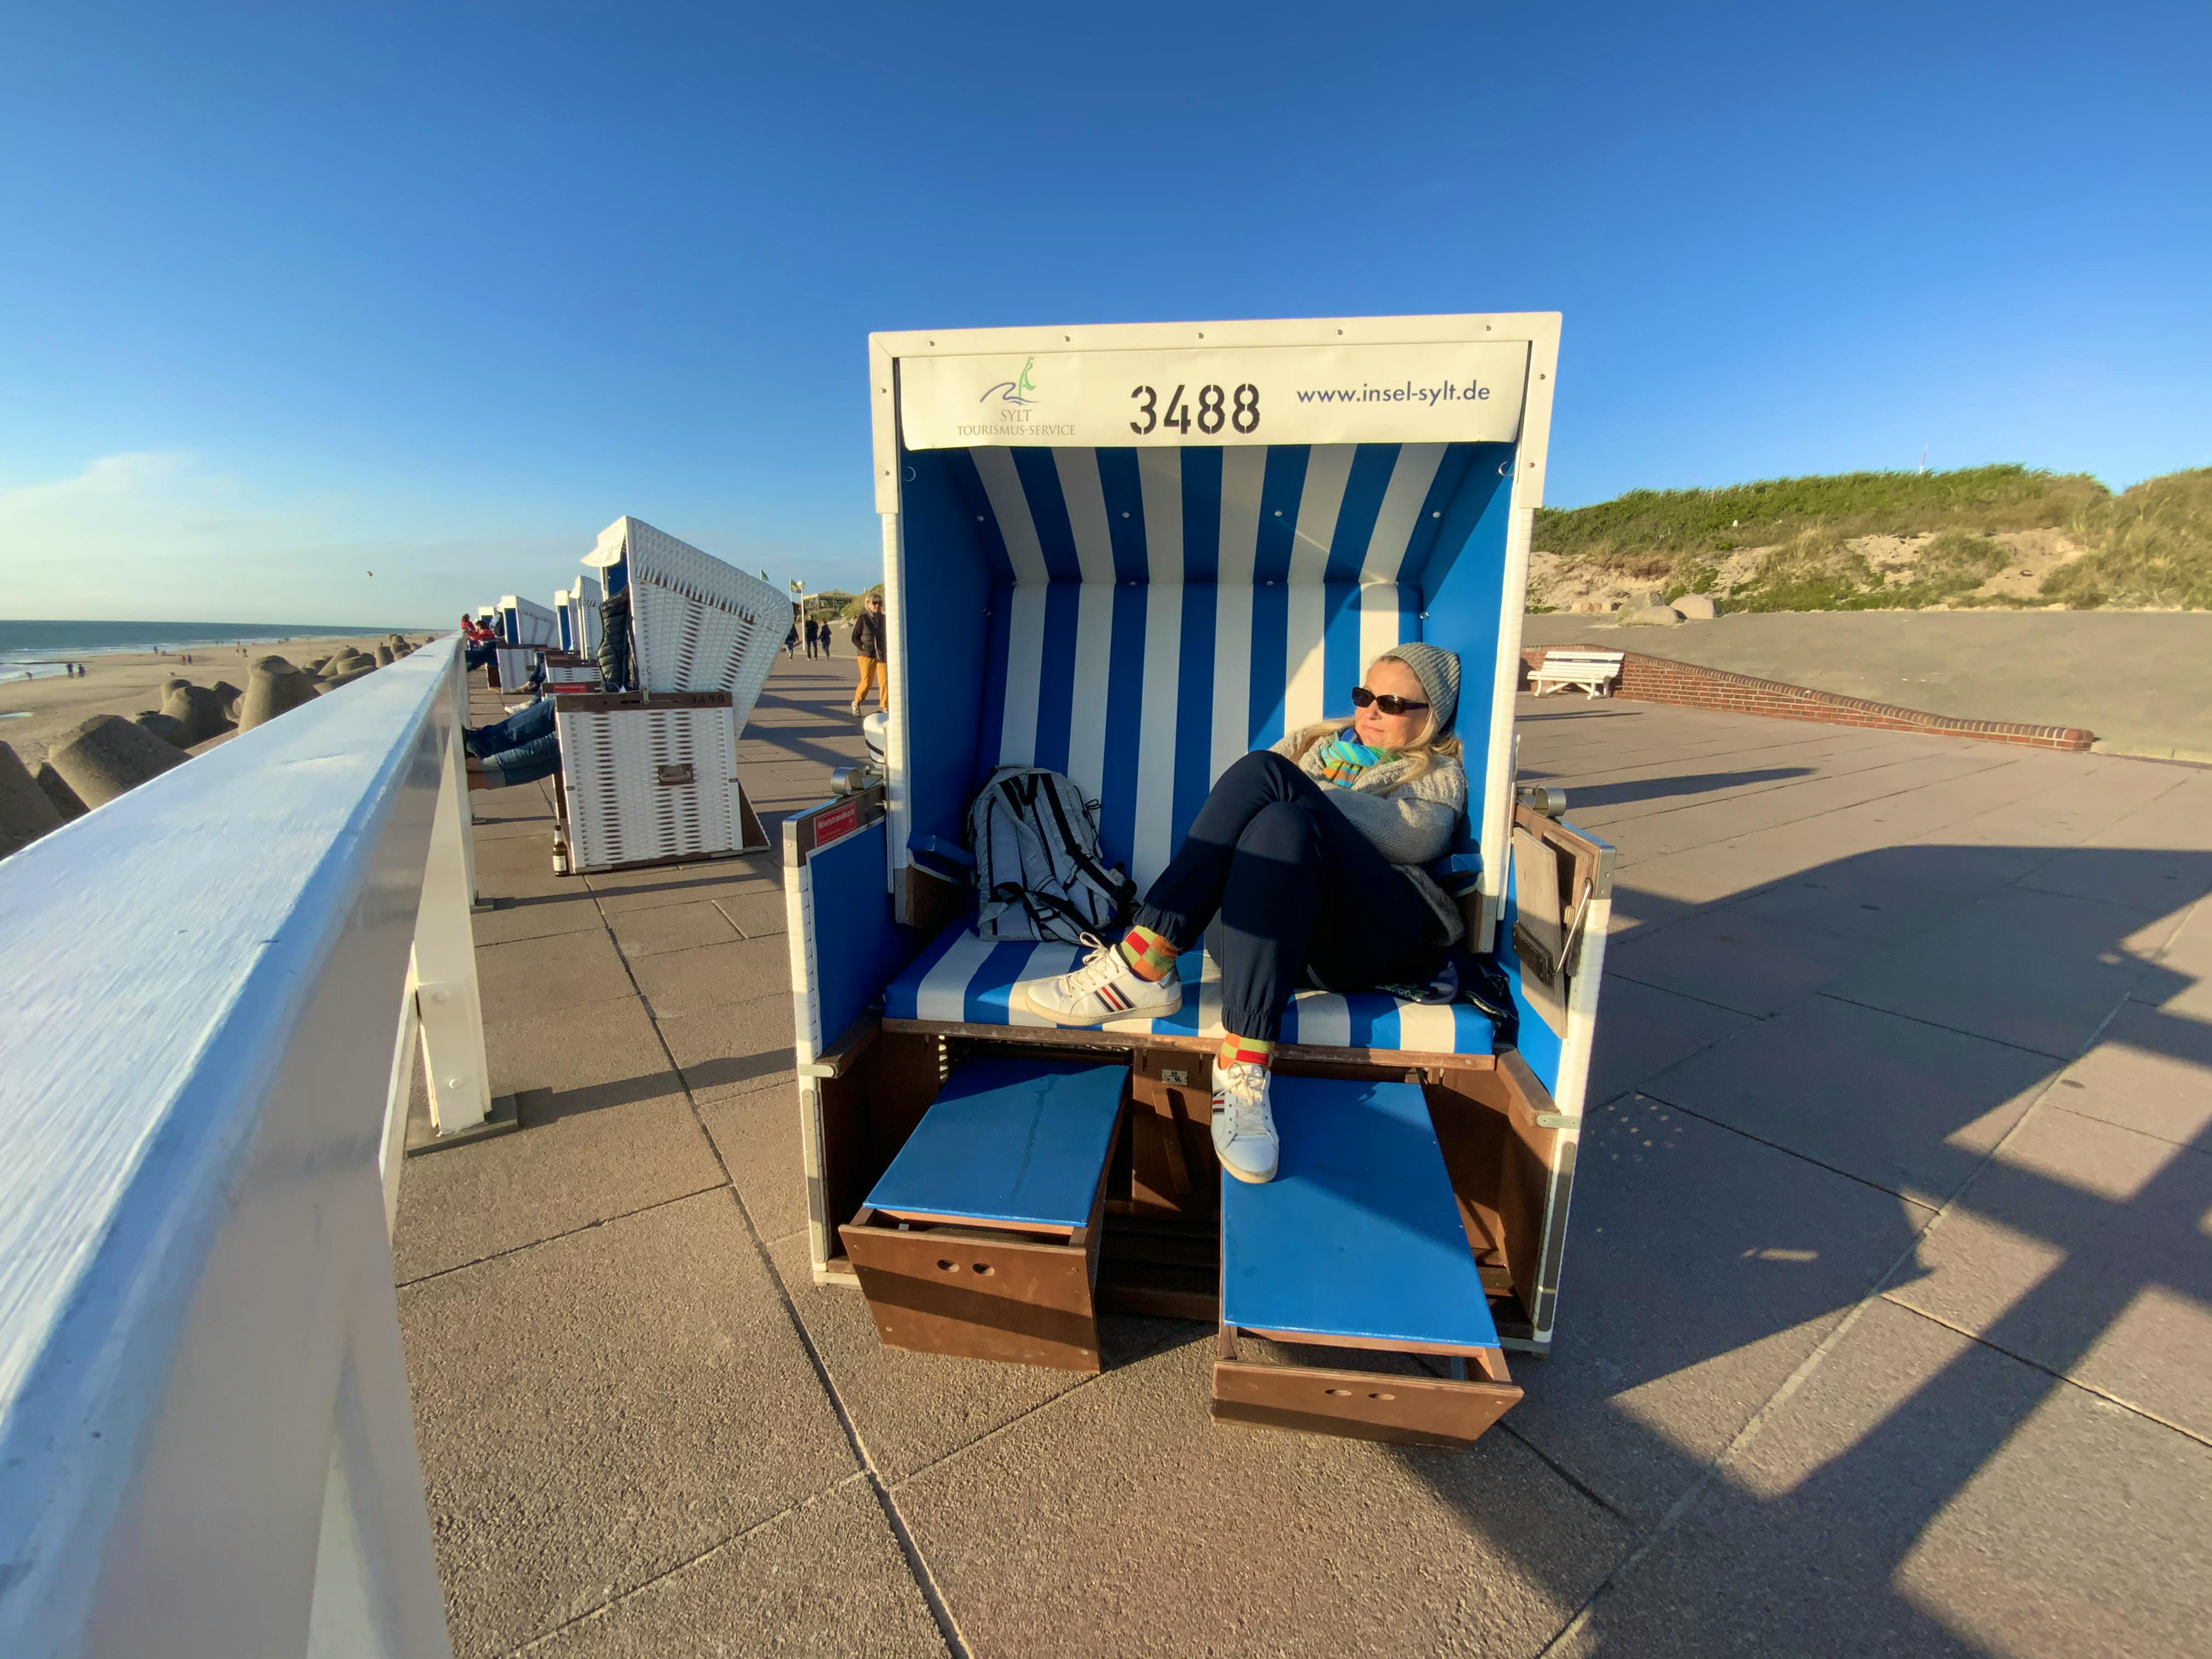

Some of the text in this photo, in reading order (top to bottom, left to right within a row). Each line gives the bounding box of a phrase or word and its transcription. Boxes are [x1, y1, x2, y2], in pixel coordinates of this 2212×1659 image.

[1296, 380, 1490, 407] www.insel-sylt.de
[1000, 409, 1032, 422] SYLT
[1129, 383, 1260, 435] 3488
[956, 425, 1076, 436] TOURISMUS-SERVICE
